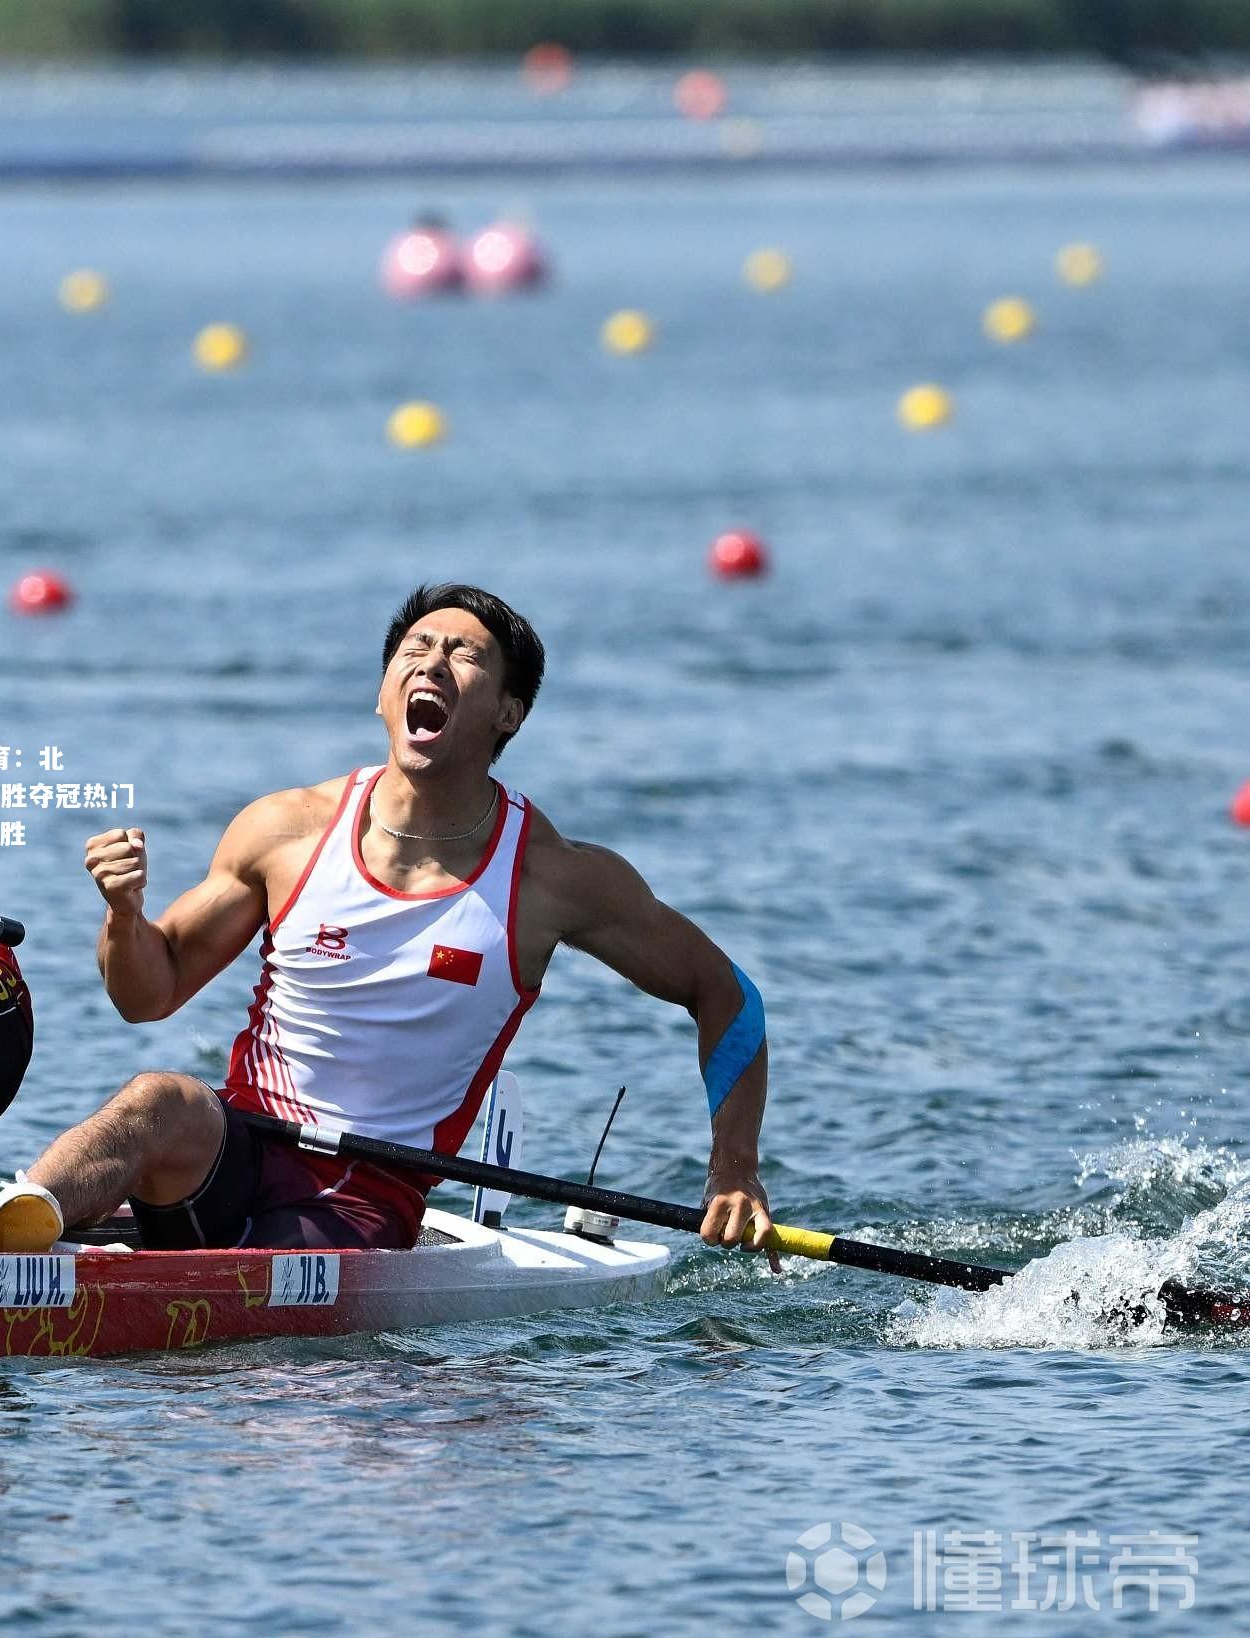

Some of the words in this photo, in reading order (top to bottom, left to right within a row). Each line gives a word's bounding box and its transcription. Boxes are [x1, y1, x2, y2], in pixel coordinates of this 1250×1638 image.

[305, 946, 352, 961] BODYWRAP
[13, 1257, 44, 1306] LIU
[46, 1257, 66, 1305] H.
[296, 1256, 312, 1304] JI
[312, 1256, 330, 1304] B.
